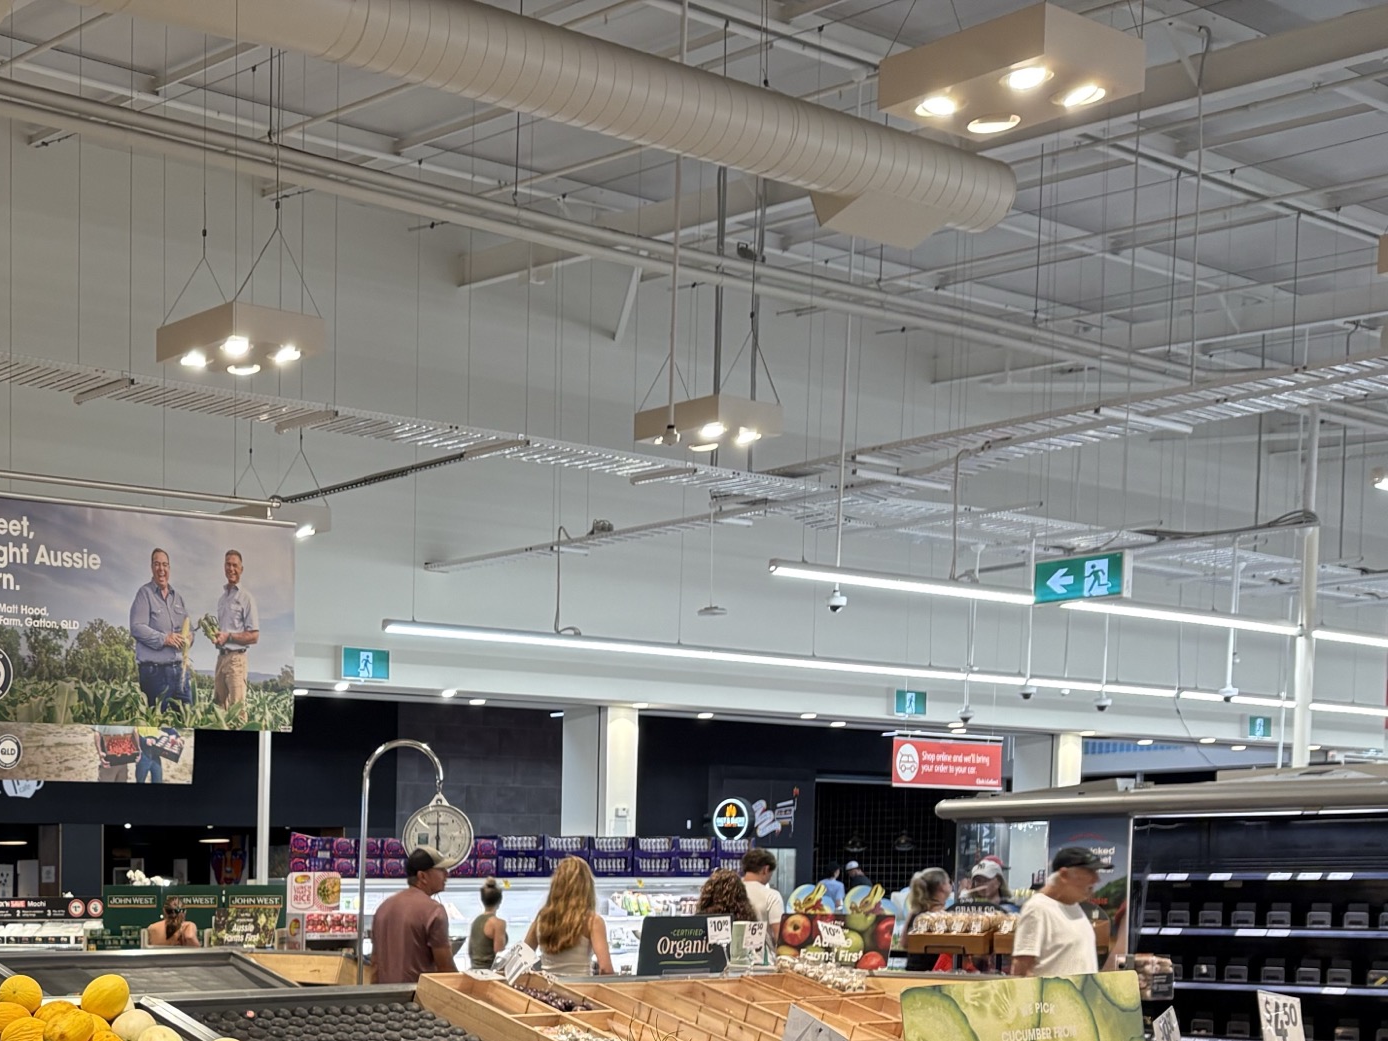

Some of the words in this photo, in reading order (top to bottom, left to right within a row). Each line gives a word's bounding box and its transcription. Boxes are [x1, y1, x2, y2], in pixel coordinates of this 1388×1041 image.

[34, 544, 101, 570] Aussie
[20, 605, 49, 617] Hood,
[0, 616, 23, 627] Farm,
[25, 617, 59, 630] Gatton,
[61, 620, 80, 630] QLD
[0, 748, 16, 756] QLD
[922, 750, 935, 762] Shop
[936, 752, 952, 762] online
[952, 753, 963, 762] and
[976, 755, 990, 766] bring
[921, 765, 934, 774] your
[934, 765, 948, 773] order
[955, 766, 967, 776] your
[110, 896, 132, 904] JOHN
[672, 929, 704, 937] CERTIFIED
[657, 936, 713, 959] Organic
[839, 950, 863, 962] First
[1035, 1002, 1055, 1014] PICK
[1054, 1026, 1077, 1039] FROM
